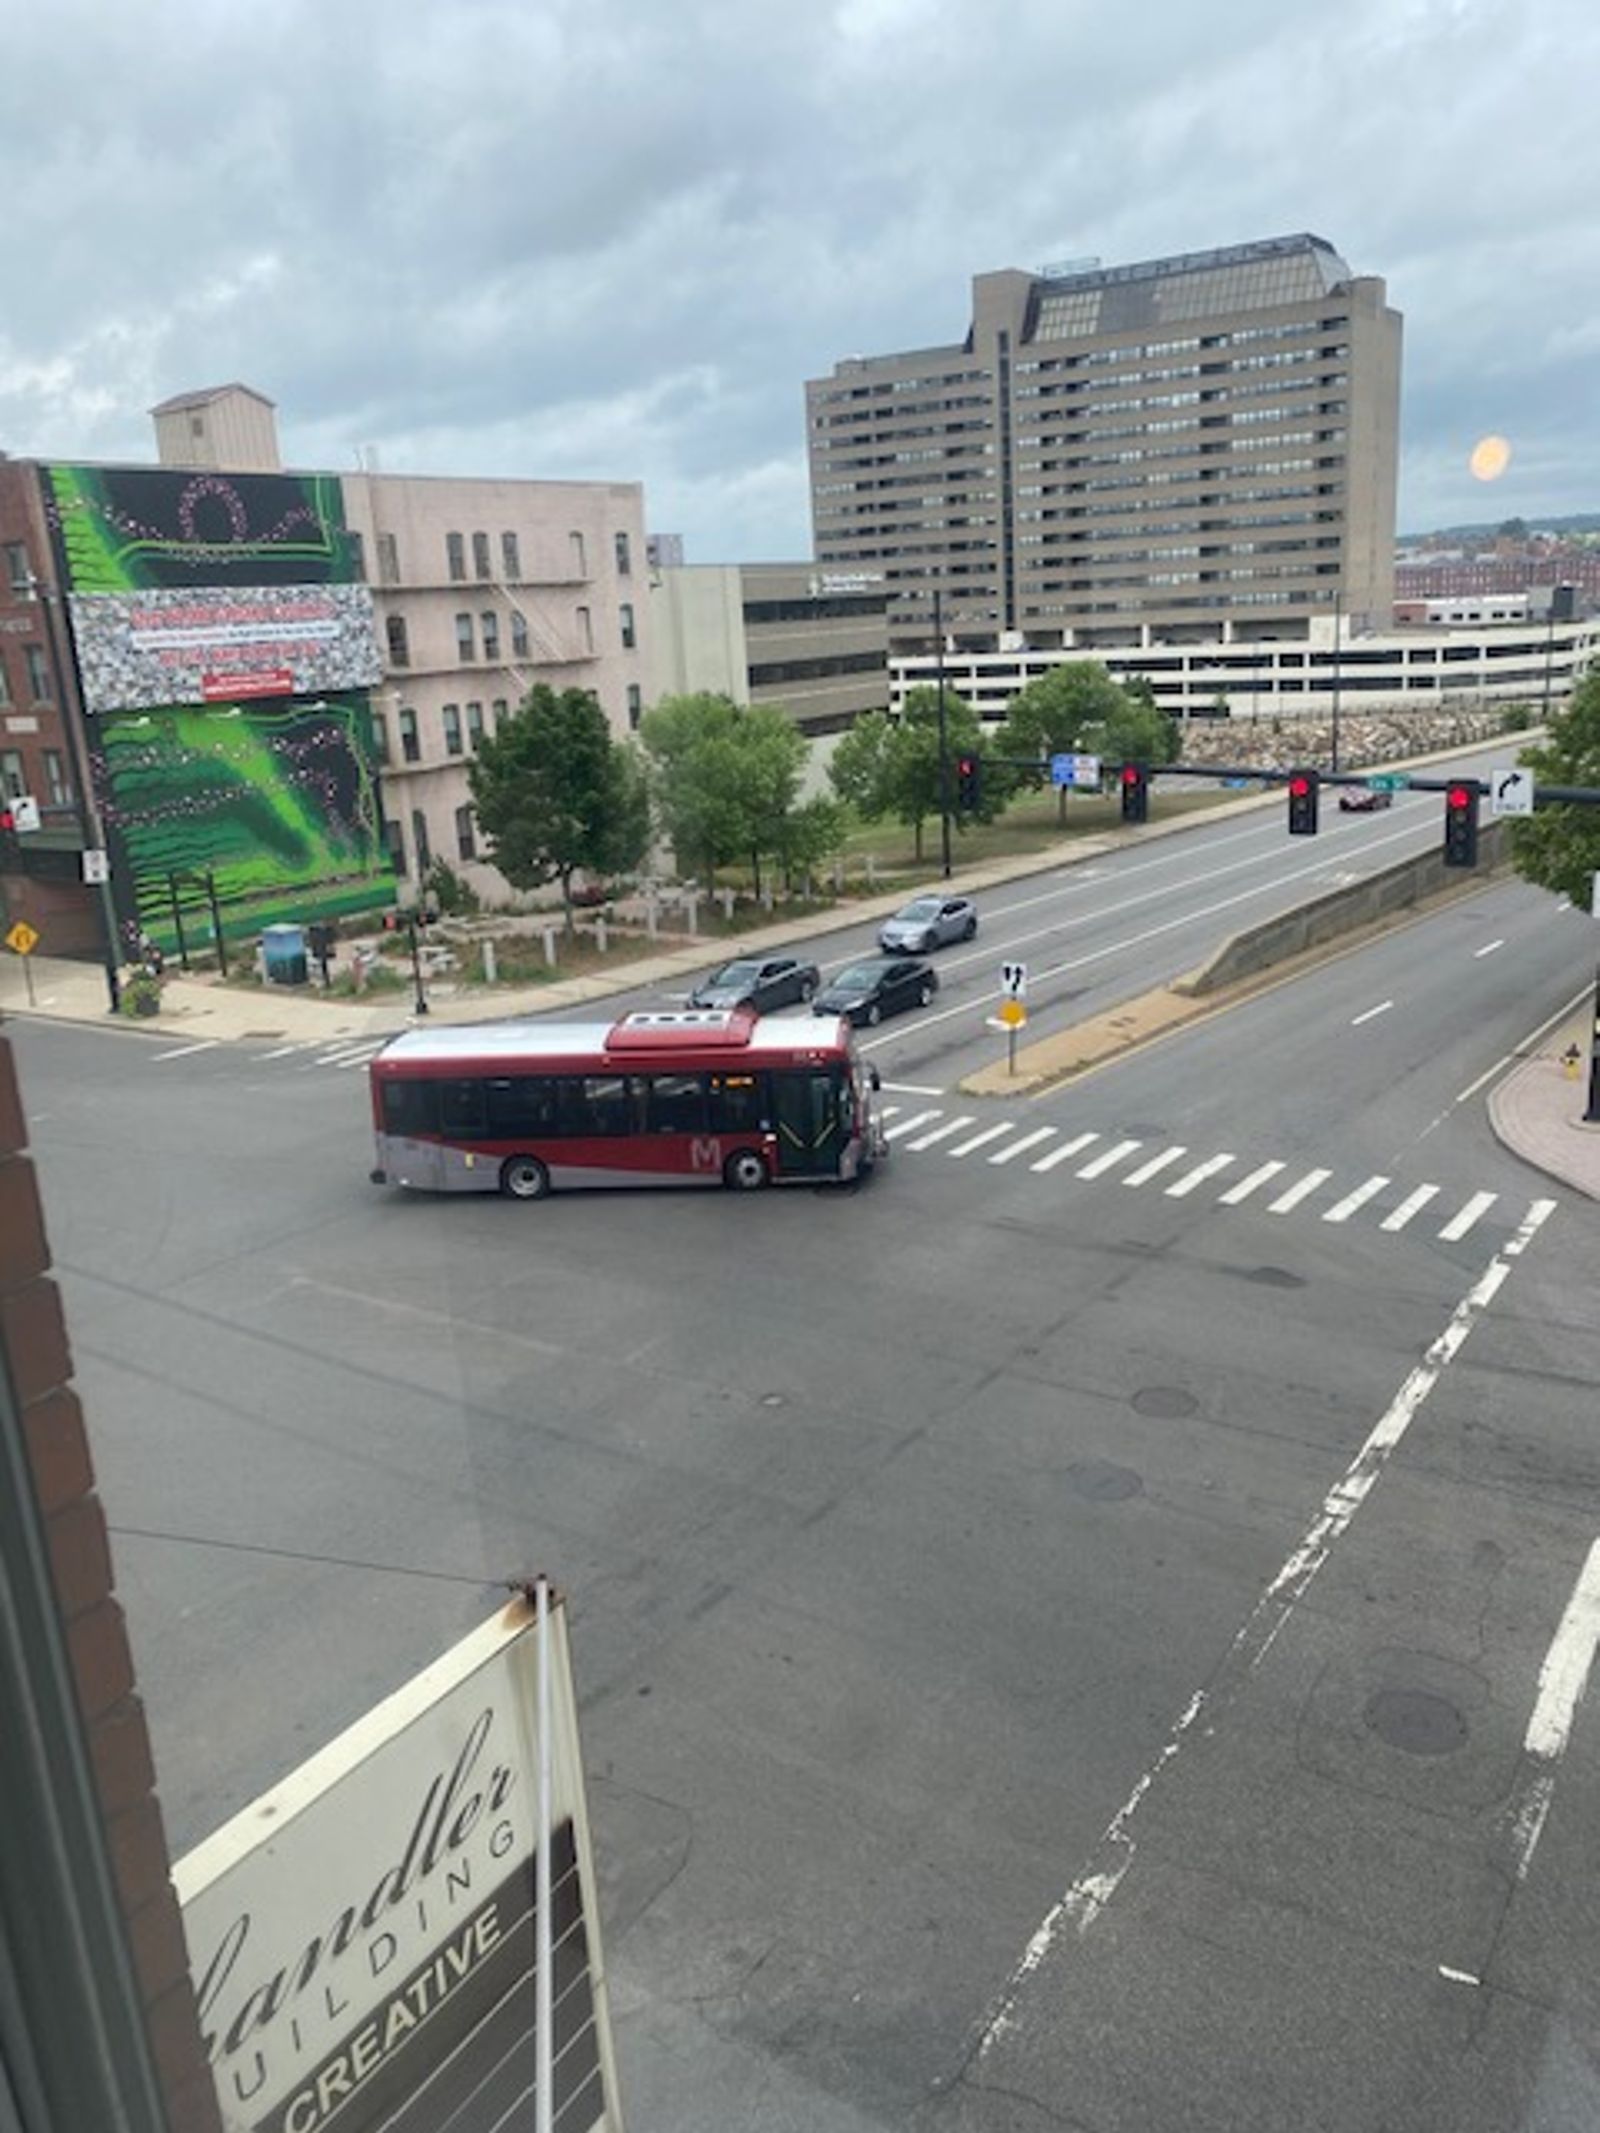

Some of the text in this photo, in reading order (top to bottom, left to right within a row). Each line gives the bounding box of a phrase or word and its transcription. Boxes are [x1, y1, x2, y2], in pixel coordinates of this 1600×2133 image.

[690, 1137, 720, 1169] M
[197, 1707, 518, 2065] handler
[233, 1819, 515, 2101] UILDING
[285, 1903, 501, 2133] CREATIVE
